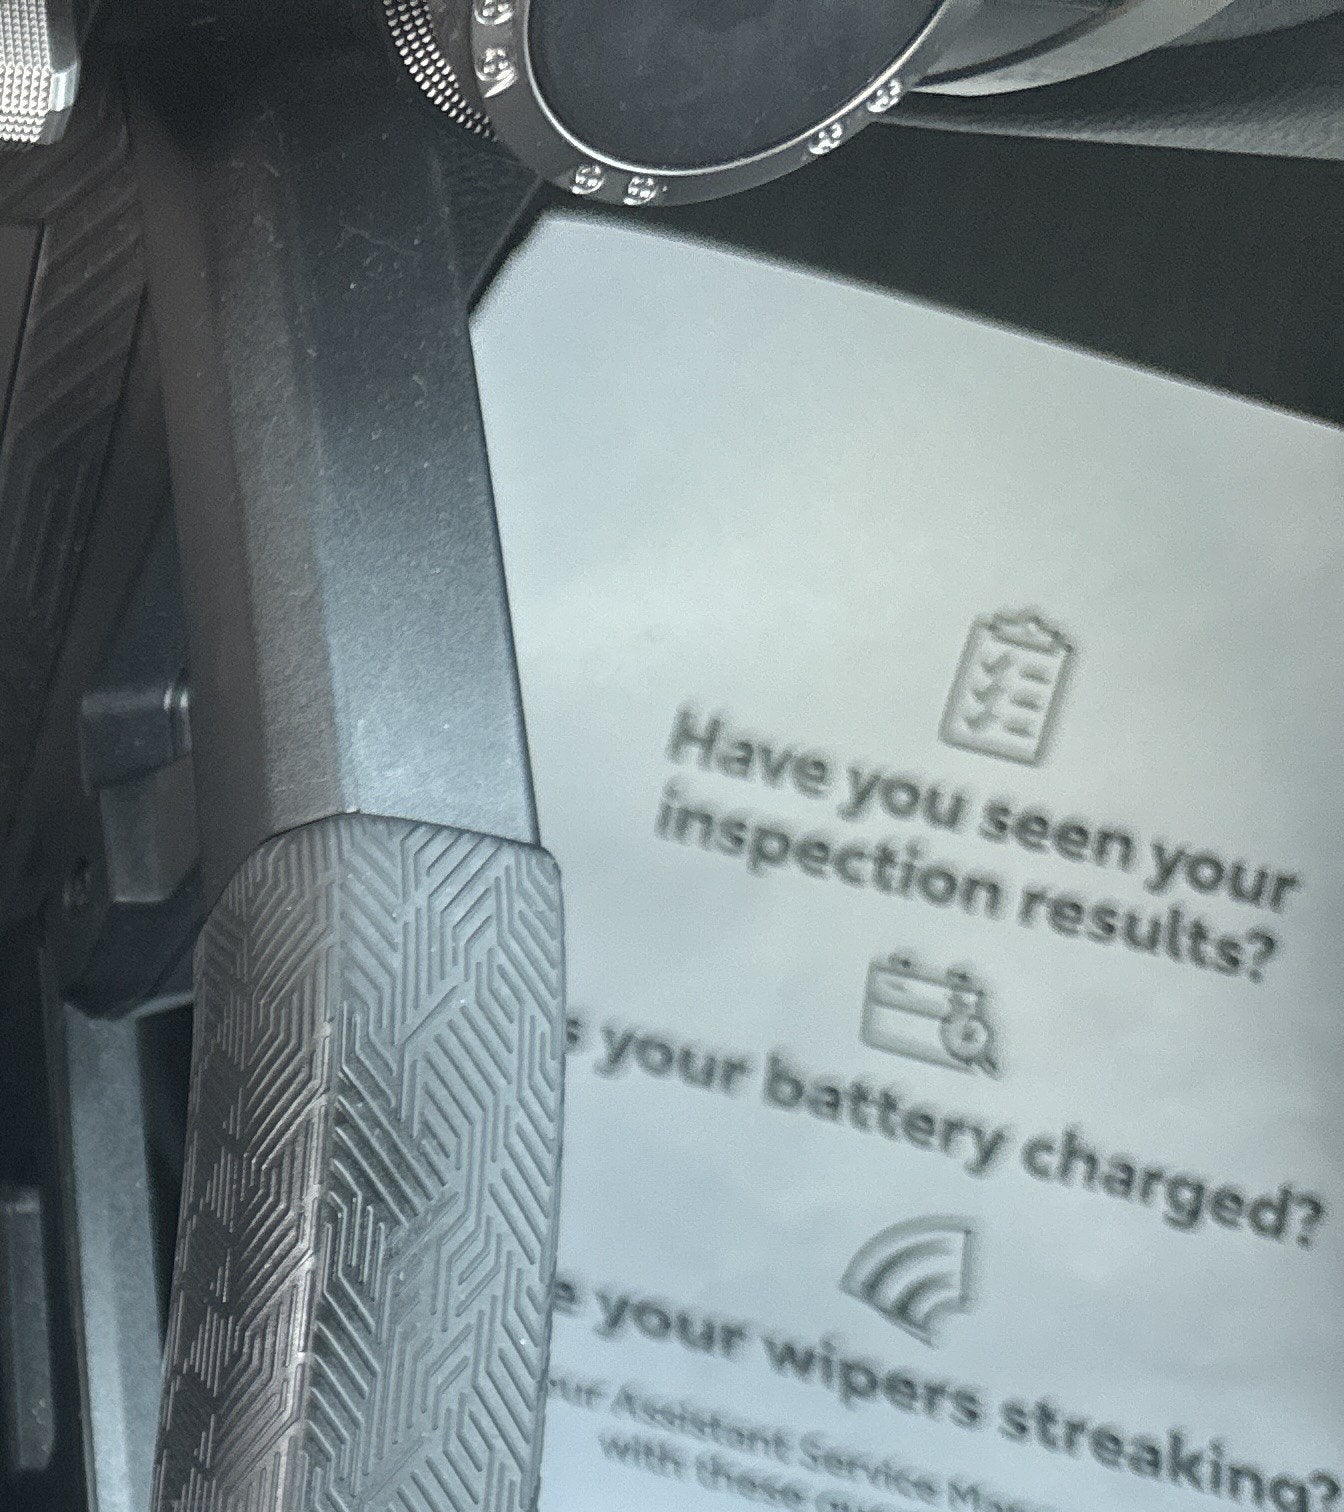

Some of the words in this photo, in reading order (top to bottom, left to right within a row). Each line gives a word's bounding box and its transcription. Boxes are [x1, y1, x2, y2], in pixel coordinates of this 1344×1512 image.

[654, 778, 1004, 922] inspection
[1017, 880, 1279, 984] results?
[665, 701, 831, 791] Have
[839, 760, 965, 830] you
[979, 793, 1136, 872] seen
[1144, 839, 1302, 915] your
[593, 1021, 750, 1097] your
[761, 1050, 1005, 1178] battery
[1019, 1123, 1325, 1250] charged?
[595, 1289, 749, 1361] your
[760, 1330, 983, 1433] wipers
